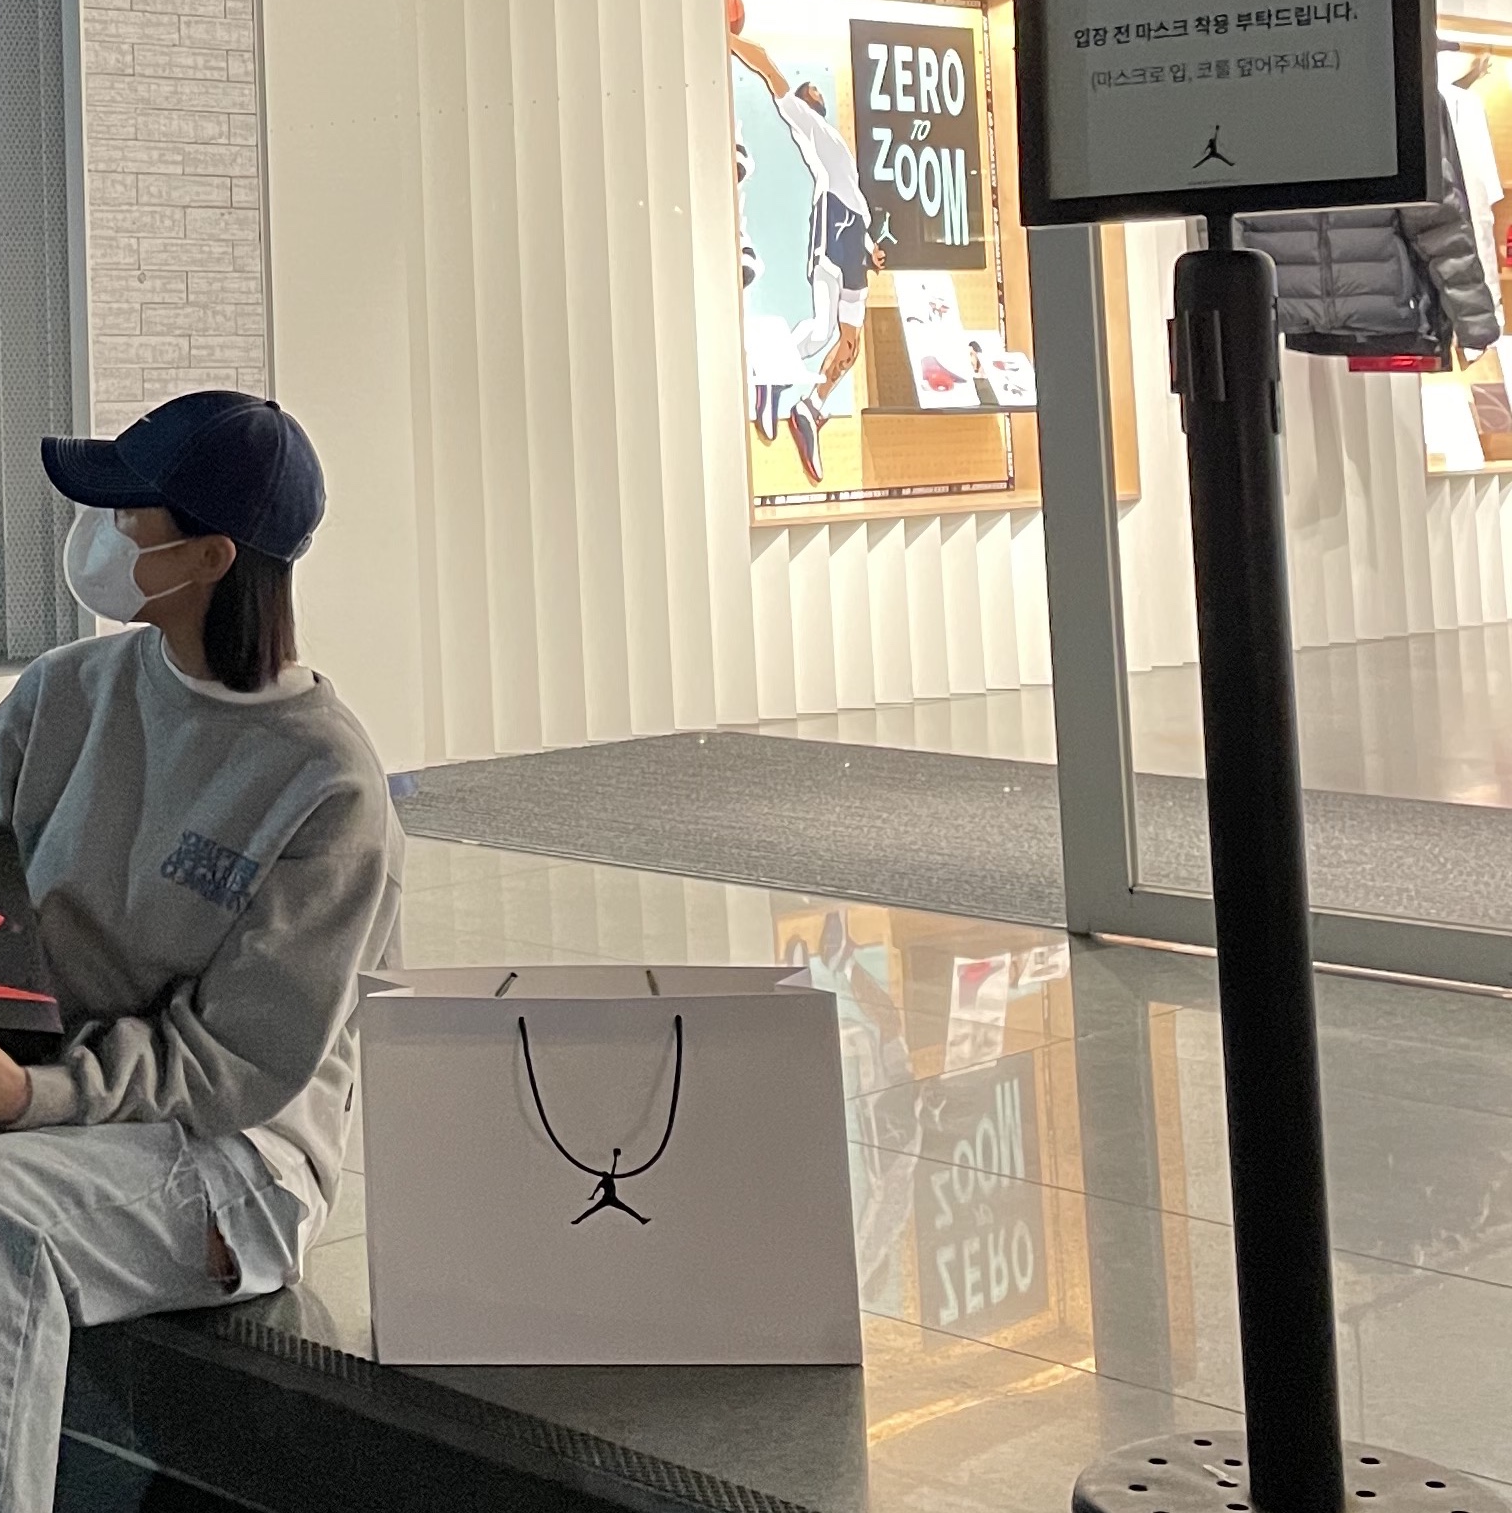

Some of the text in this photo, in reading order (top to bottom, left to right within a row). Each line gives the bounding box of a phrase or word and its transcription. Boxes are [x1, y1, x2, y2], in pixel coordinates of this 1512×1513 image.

[1073, 1, 1358, 49] 입장 전 마스크 착용 부탁드립니다.
[867, 42, 966, 116] ZERO
[1091, 65, 1166, 91] (마스크로
[1196, 59, 1231, 80] 코를
[910, 119, 932, 142] TO
[871, 127, 970, 246] ZOOM
